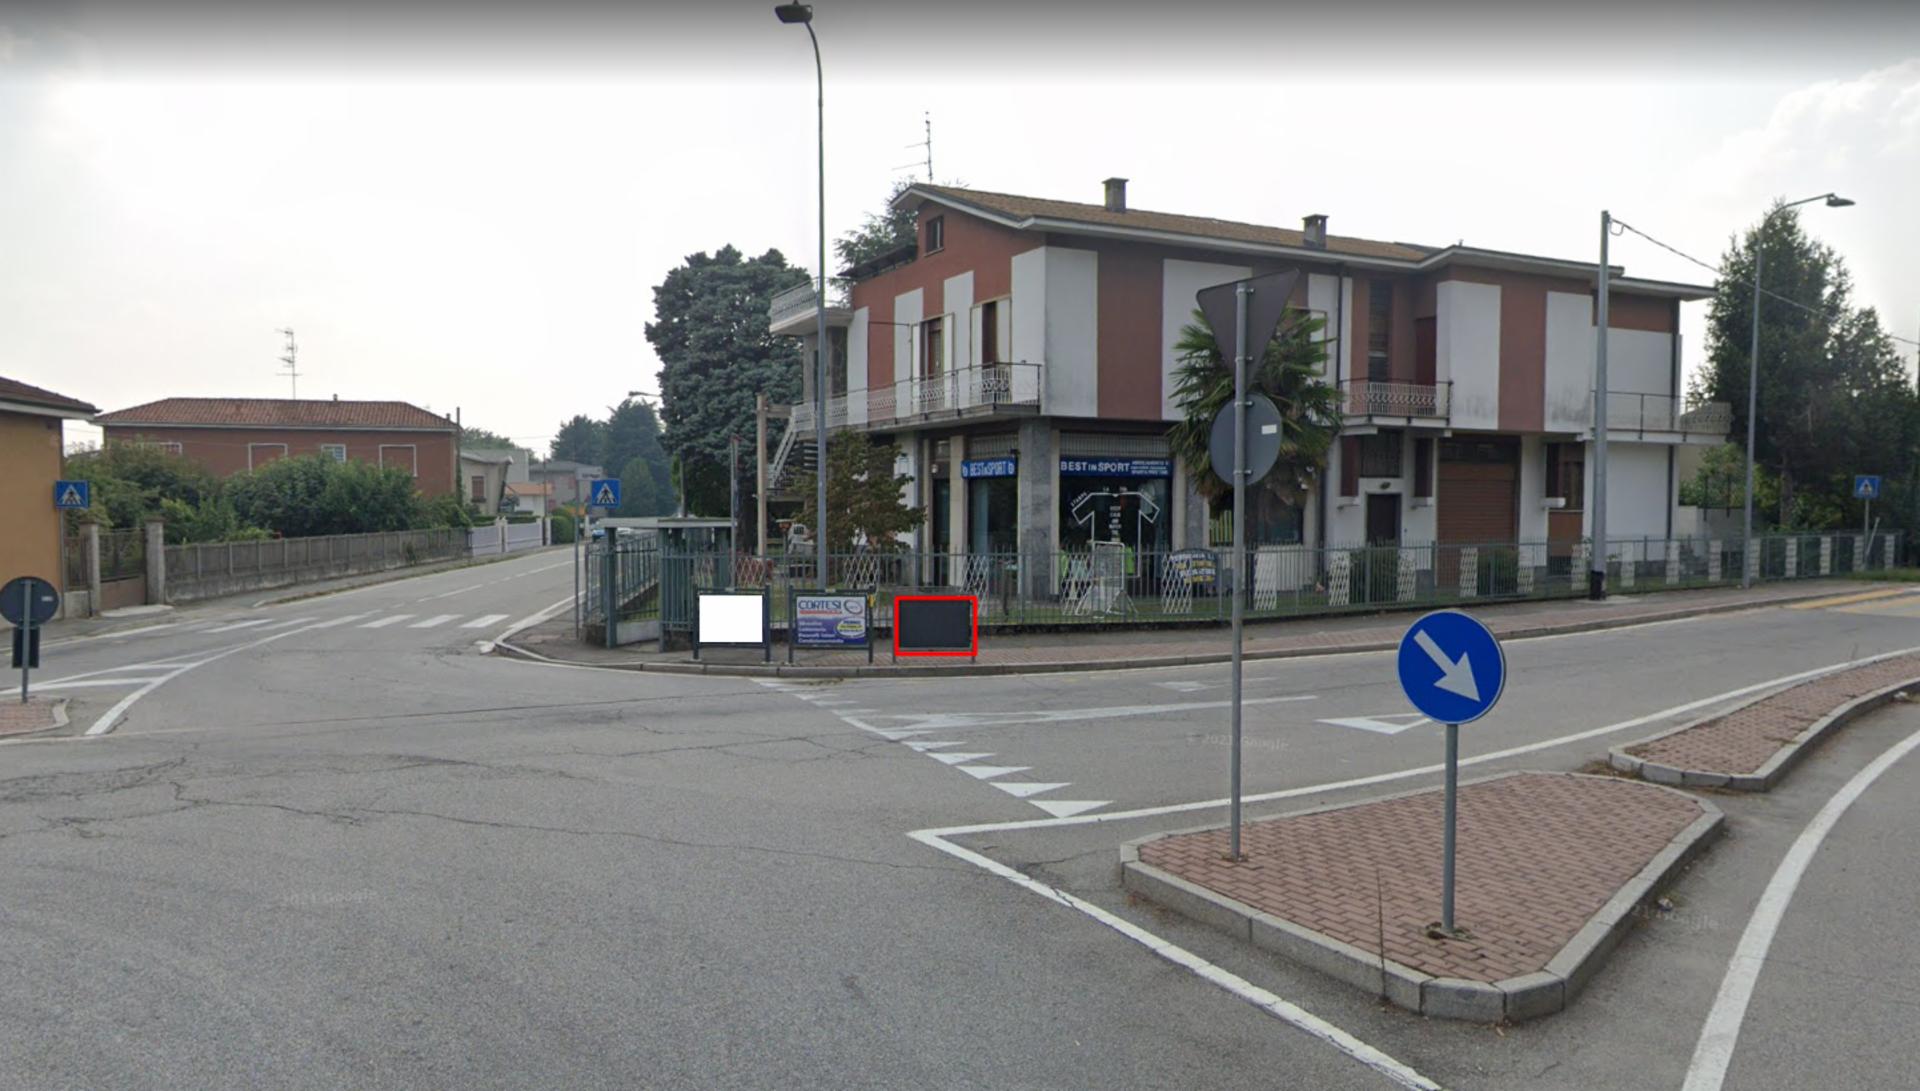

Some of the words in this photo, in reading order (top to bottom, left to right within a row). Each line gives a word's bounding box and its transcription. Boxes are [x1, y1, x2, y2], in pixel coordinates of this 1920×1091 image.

[1060, 461, 1087, 471] BEST
[1098, 462, 1130, 472] SPORT
[799, 600, 841, 609] CORTESI
